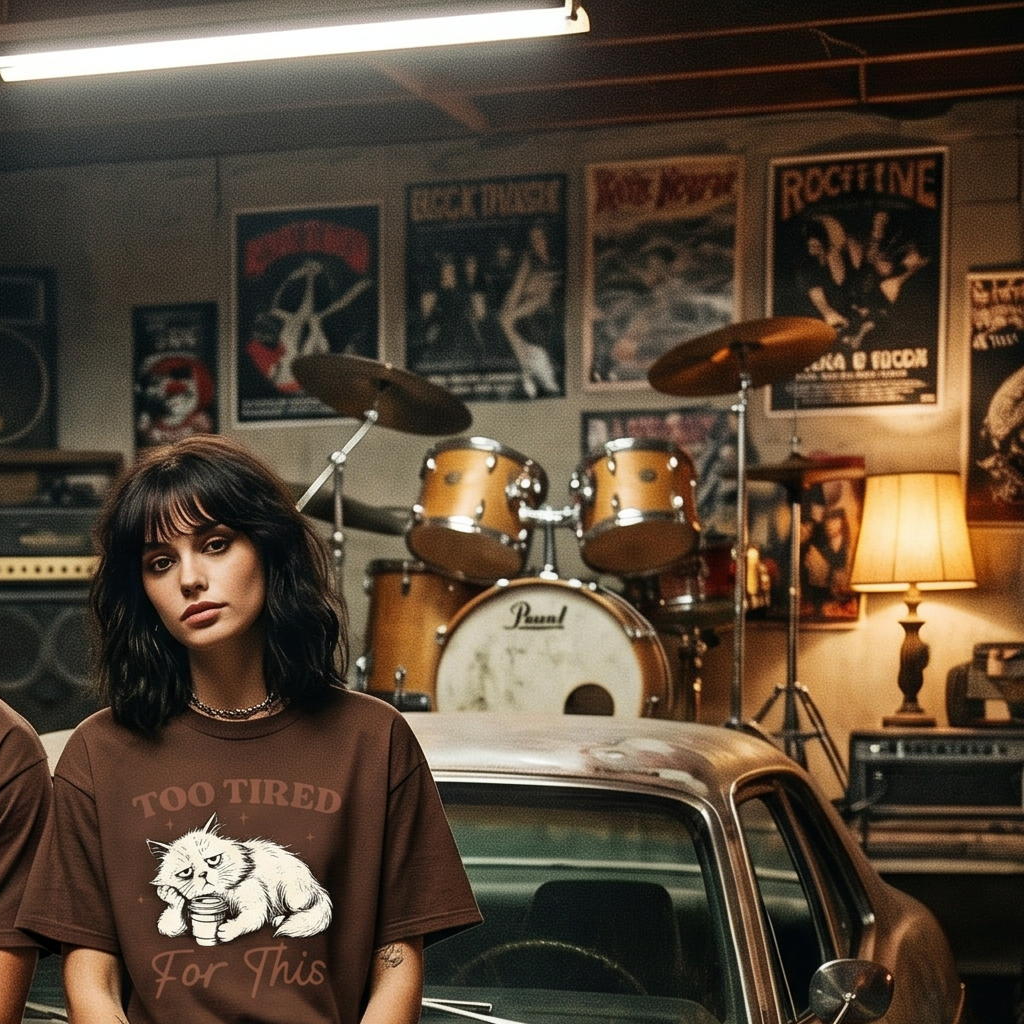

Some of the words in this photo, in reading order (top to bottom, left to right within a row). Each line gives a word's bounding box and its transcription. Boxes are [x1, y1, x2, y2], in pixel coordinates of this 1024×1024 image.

[131, 781, 216, 819] TOO
[222, 778, 343, 815] TIRED
[151, 949, 229, 1000] For
[243, 942, 327, 999] This
